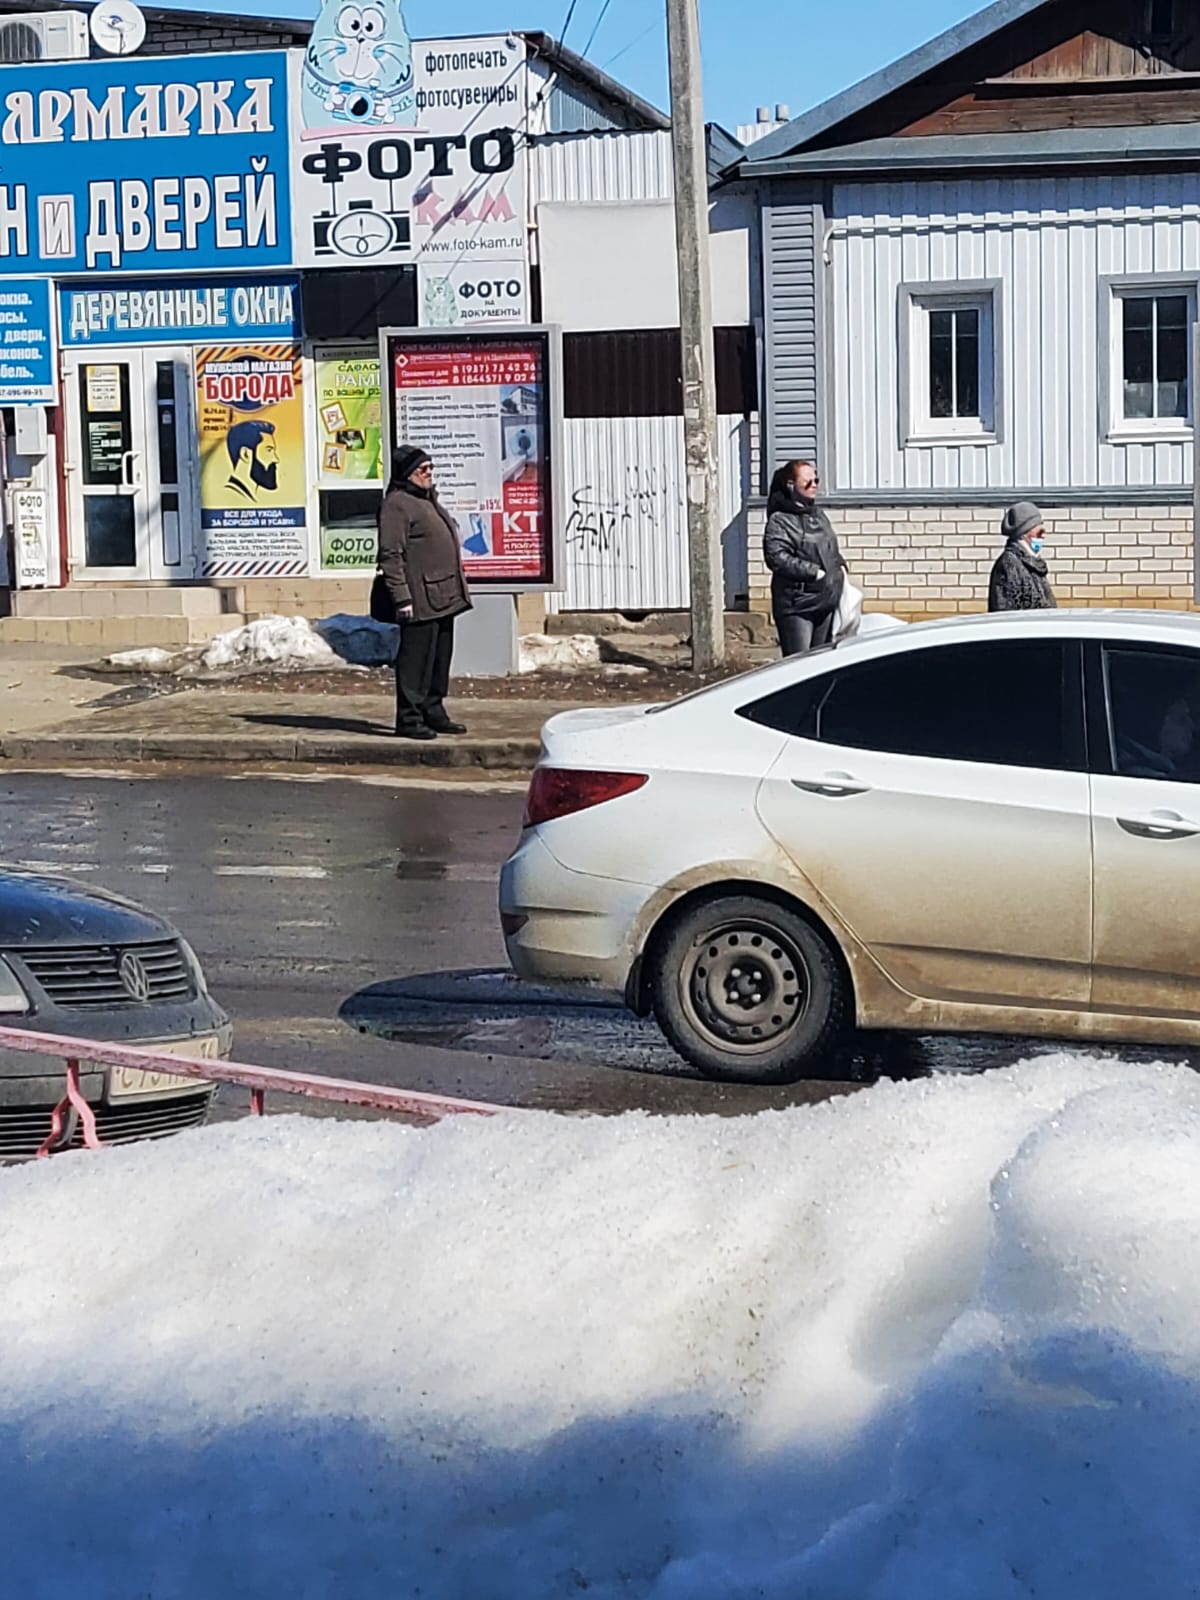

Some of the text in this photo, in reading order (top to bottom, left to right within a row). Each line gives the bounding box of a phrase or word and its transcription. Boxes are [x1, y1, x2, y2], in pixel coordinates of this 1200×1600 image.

[425, 50, 508, 76] фотопечать
[2, 78, 274, 144] ЯРМАРКА
[416, 84, 518, 111] фотосувениры
[302, 131, 516, 183] ФОТО
[86, 155, 277, 268] ДВЕРЕЙ
[421, 237, 523, 252] www.foto-kam.ru
[458, 280, 521, 299] ФОТО
[70, 284, 296, 339] ДЕРЕВЯННЫЕ ОКНА
[460, 308, 521, 318] ДОКУМЕНТЫ
[205, 374, 294, 403] БОРОДА
[330, 537, 374, 551] ФОТО
